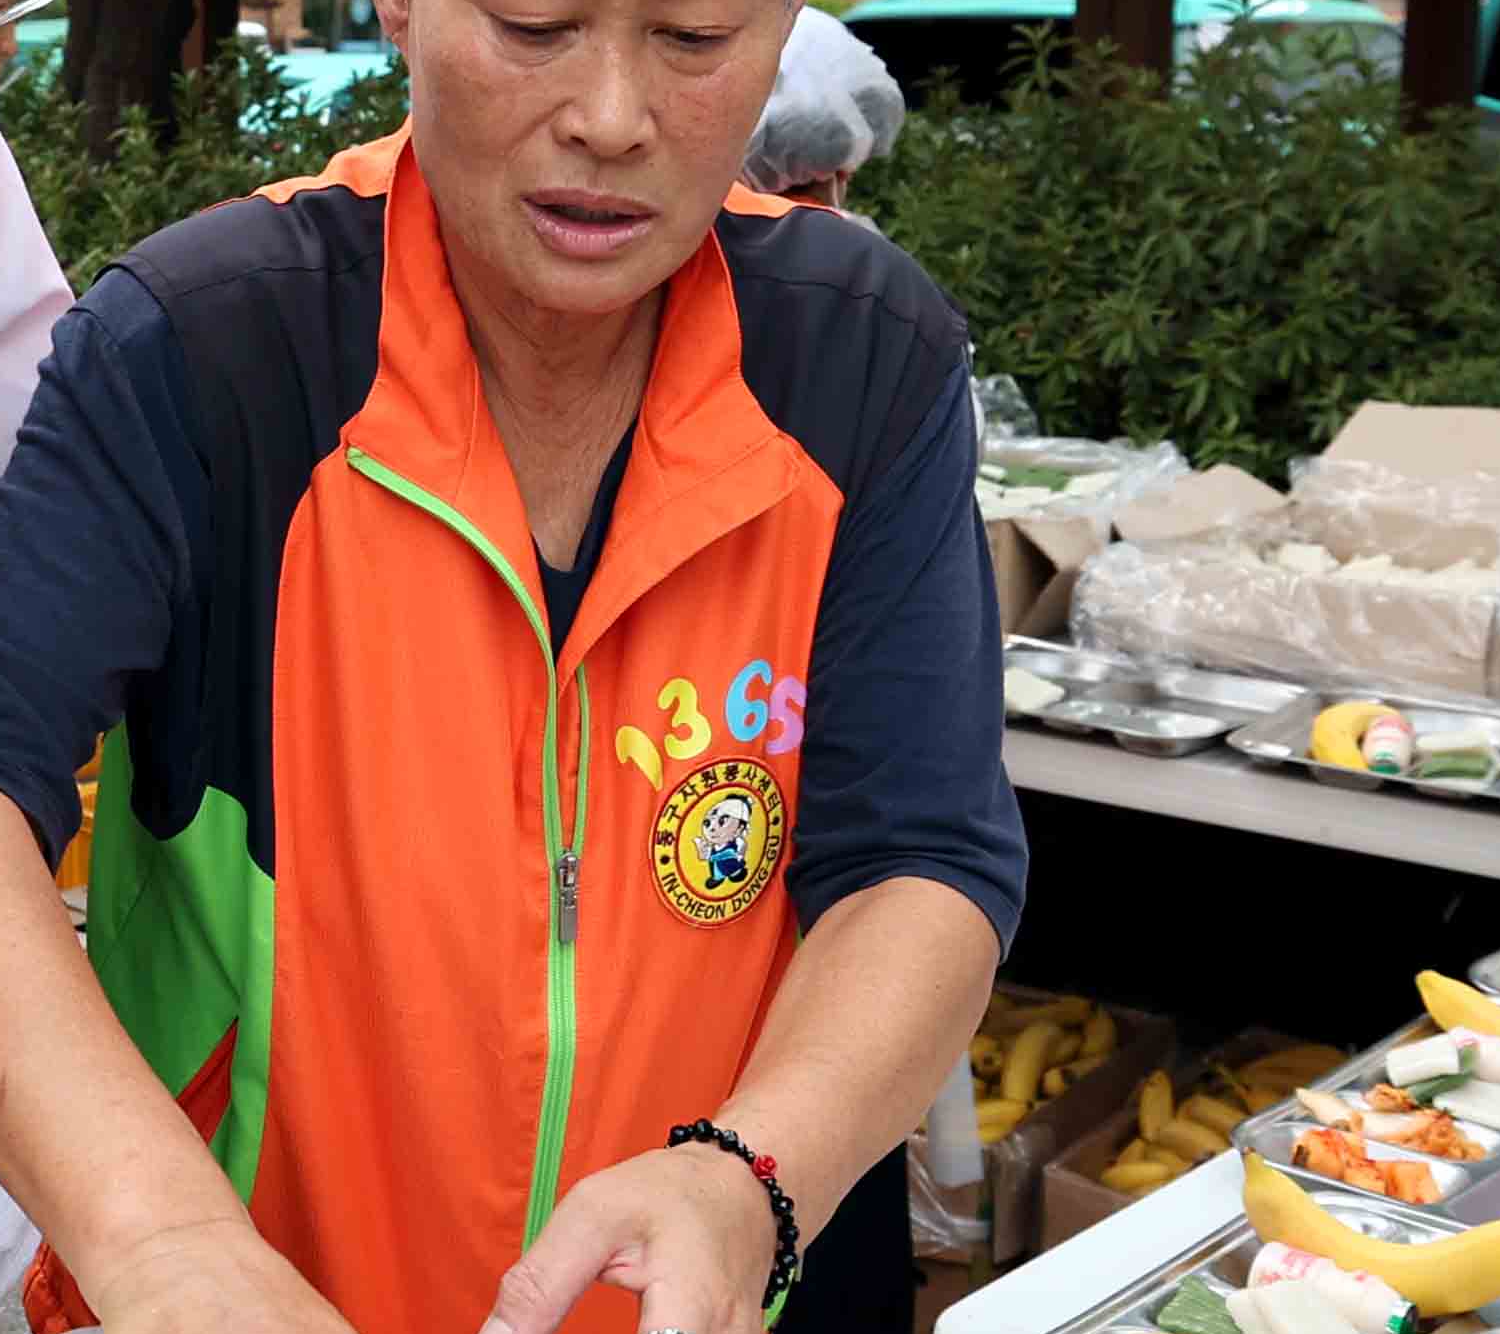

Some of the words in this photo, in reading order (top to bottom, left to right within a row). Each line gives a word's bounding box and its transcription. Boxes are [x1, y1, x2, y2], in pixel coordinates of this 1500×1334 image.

[615, 659, 808, 792] 1365
[662, 873, 726, 920] IN-CHEON
[732, 835, 780, 912] DONG-GU
